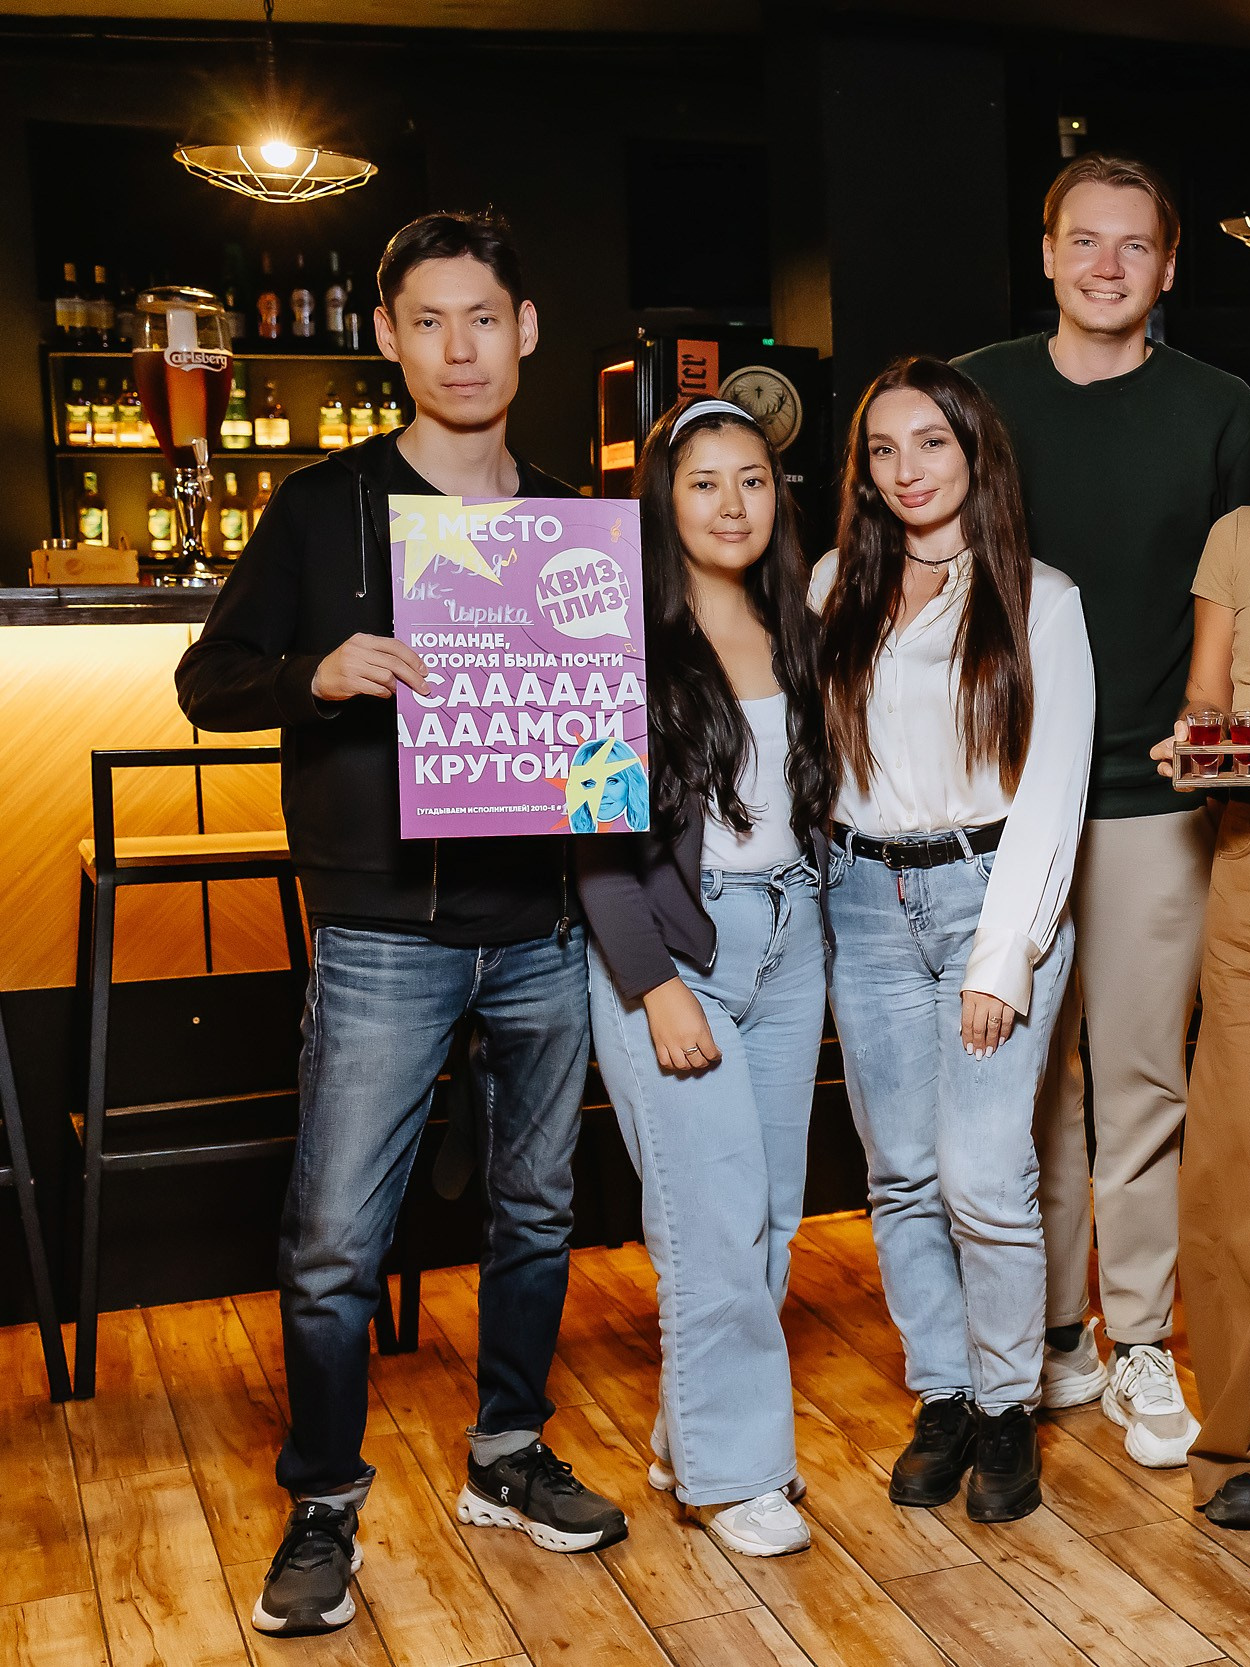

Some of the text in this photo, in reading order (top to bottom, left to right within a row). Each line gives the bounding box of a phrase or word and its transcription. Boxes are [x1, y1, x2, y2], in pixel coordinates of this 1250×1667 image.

[164, 347, 227, 372] Carlsberg
[407, 512, 563, 543] 2 МЕСТО
[411, 633, 511, 650] КОМАНДЕ,
[419, 652, 624, 668] ОТОРАЯ БЫЛА ПОЧТИ
[415, 745, 569, 785] КРУТОЙ
[416, 806, 467, 816] [УГАДЫВАЕМ
